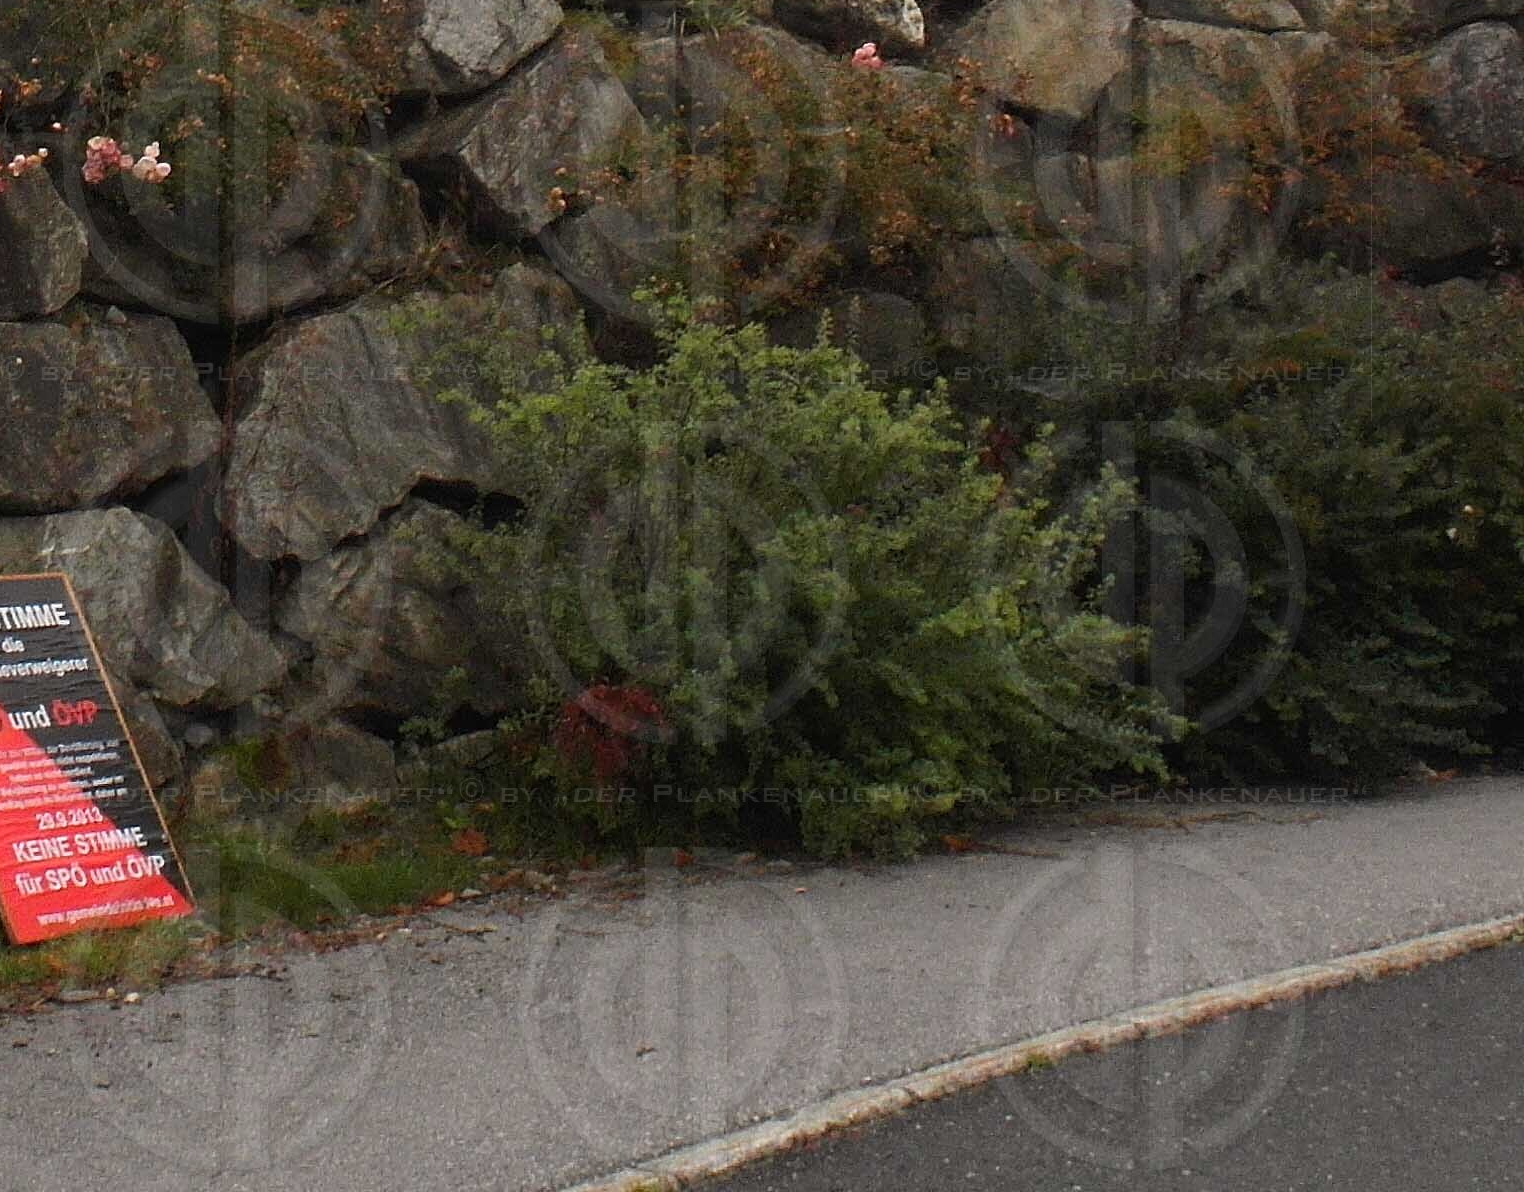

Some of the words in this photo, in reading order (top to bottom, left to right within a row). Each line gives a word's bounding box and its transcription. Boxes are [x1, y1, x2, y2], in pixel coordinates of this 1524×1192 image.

[2, 636, 25, 653] die
[8, 704, 52, 730] und
[12, 835, 74, 863] KEINE
[74, 826, 148, 855] STIMME
[15, 872, 44, 896] für
[45, 862, 87, 891] SPÖ
[90, 861, 125, 885] und
[127, 854, 165, 879] ÖVP
